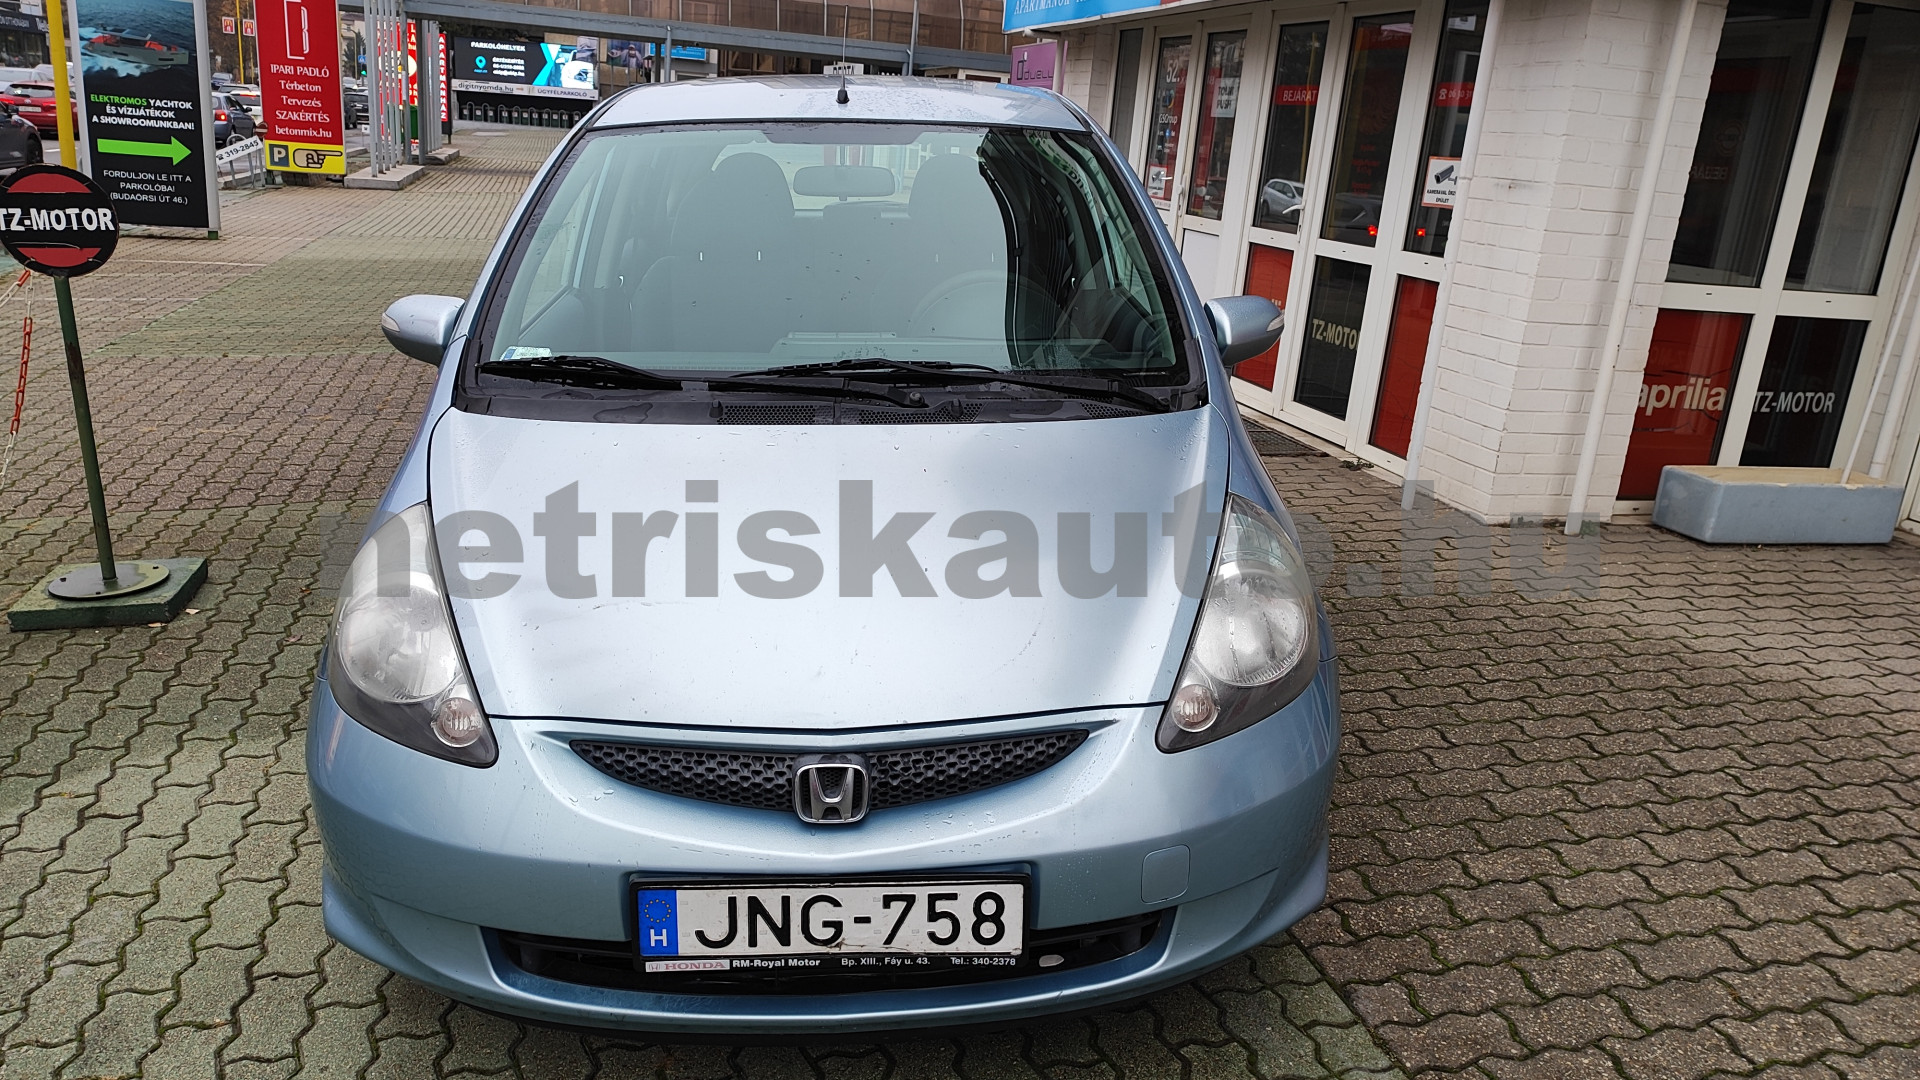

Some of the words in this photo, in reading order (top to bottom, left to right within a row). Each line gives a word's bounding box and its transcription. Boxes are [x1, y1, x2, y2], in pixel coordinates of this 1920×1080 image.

[470, 41, 526, 52] PARKOLÓHELYEK
[270, 64, 295, 75] IPARI
[296, 66, 330, 78] PADLÓ
[279, 80, 322, 93] Térbeton
[458, 82, 514, 93] digitnyomda.hu
[537, 88, 588, 98] ÜGYFÉLPARKOLÓ
[90, 94, 148, 106] ELEKTROMOS
[149, 99, 194, 110] YACHTOK
[281, 95, 322, 107] Tervezés
[1282, 88, 1318, 102] BEJÁRAT
[106, 104, 117, 114] ÉS
[117, 105, 176, 119] VÍZIJÁTÉKOK
[275, 110, 330, 123] SZAKÉRTÉS
[92, 115, 99, 123] A
[100, 115, 195, 130] SHOWROOMUNKBAN!
[275, 125, 332, 138] betonmix.hu
[224, 140, 259, 158] 319-2845
[103, 170, 155, 180] FORDULJON
[156, 173, 168, 181] LE
[170, 174, 183, 182] ITT
[120, 182, 176, 192] PARKOLÓBA!
[110, 192, 157, 202] (BUDAÖRSI
[158, 194, 171, 203] ÚT
[172, 196, 188, 205] 46.)
[0, 207, 115, 231] TZ-MOTOR
[1312, 318, 1361, 350] TZ-MOTO
[1637, 377, 1728, 416] aprilia
[1753, 391, 1836, 414] TZ-MOTOR
[694, 891, 1006, 949] JNG-758
[650, 929, 668, 947] H
[664, 962, 727, 971] HONDA
[732, 959, 785, 969] RM-Royal
[788, 959, 821, 967] Motor
[841, 958, 857, 967] Bp.
[860, 957, 882, 966] XIII.,
[884, 957, 902, 967] Fáy
[916, 957, 931, 965] 43.
[950, 957, 970, 965] Tel.:
[972, 957, 1017, 966] 340-2378
